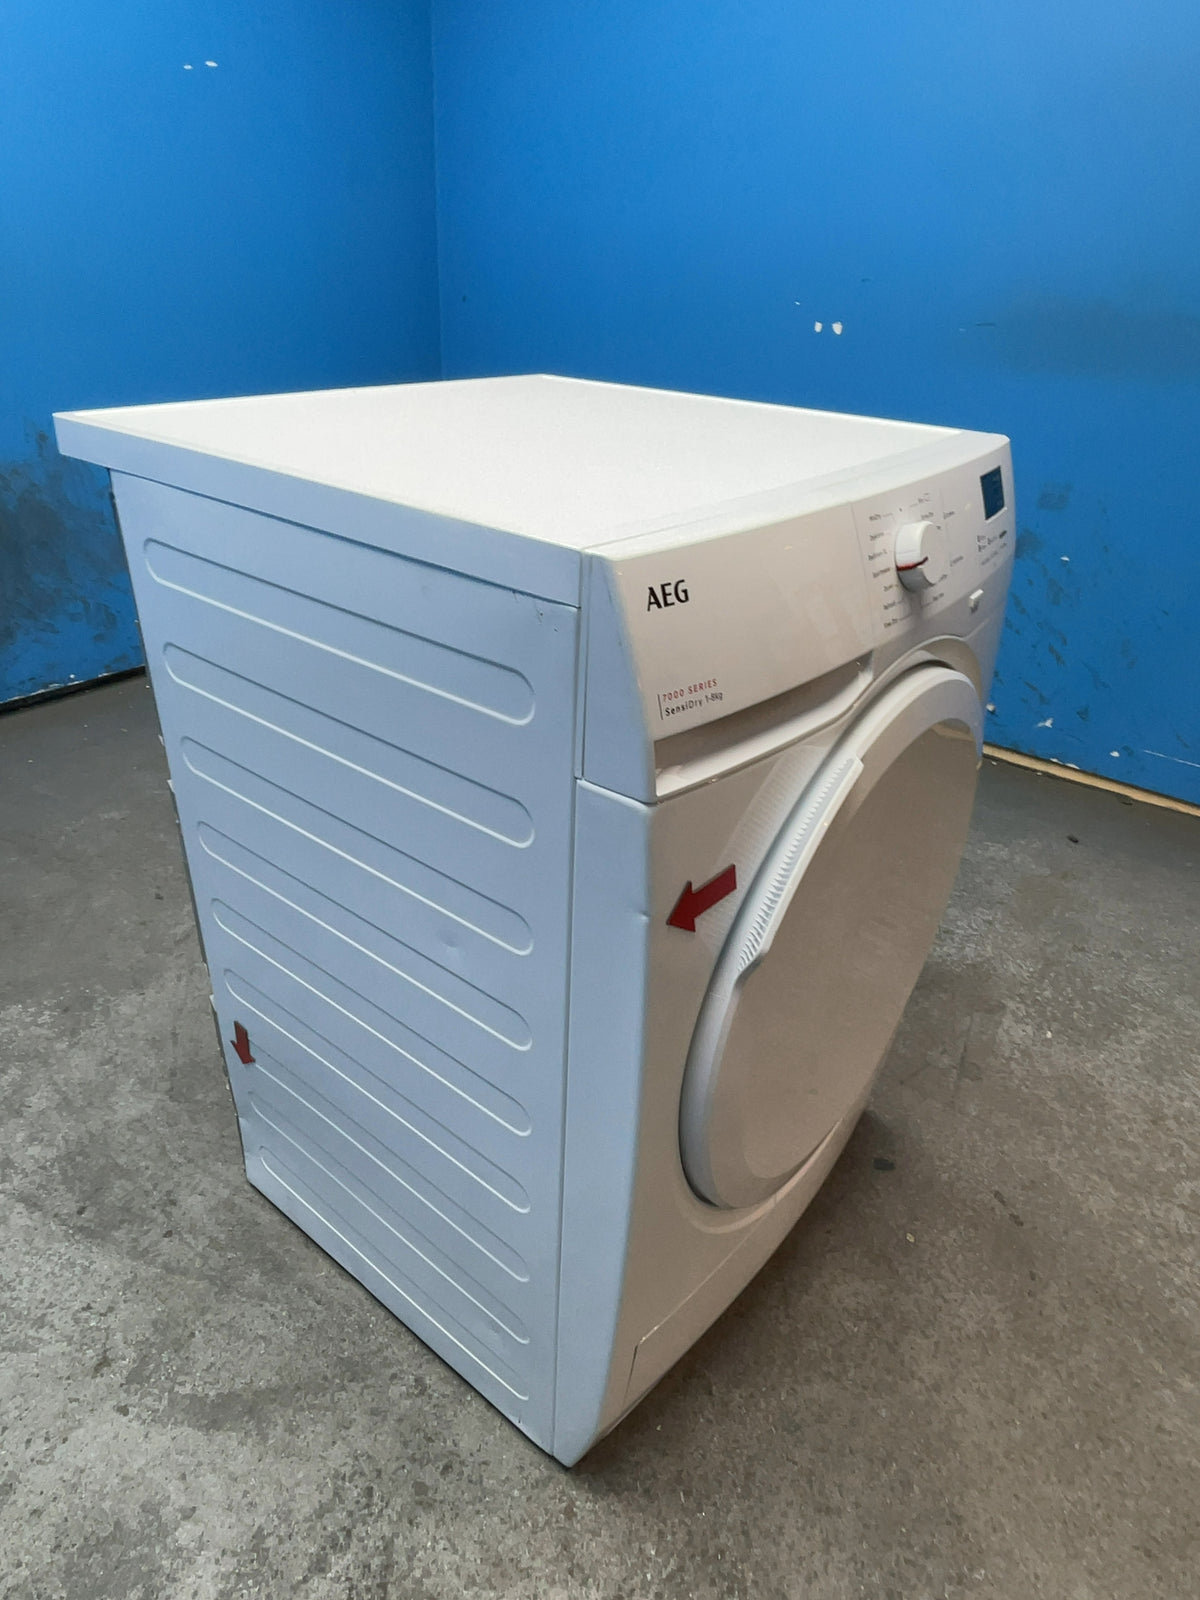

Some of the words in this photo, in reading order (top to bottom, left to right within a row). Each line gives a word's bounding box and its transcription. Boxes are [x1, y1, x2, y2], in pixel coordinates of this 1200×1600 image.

[647, 579, 689, 612] AEG
[662, 688, 685, 702] 7000
[688, 678, 718, 694] SERIES
[665, 699, 703, 717] SensiDry
